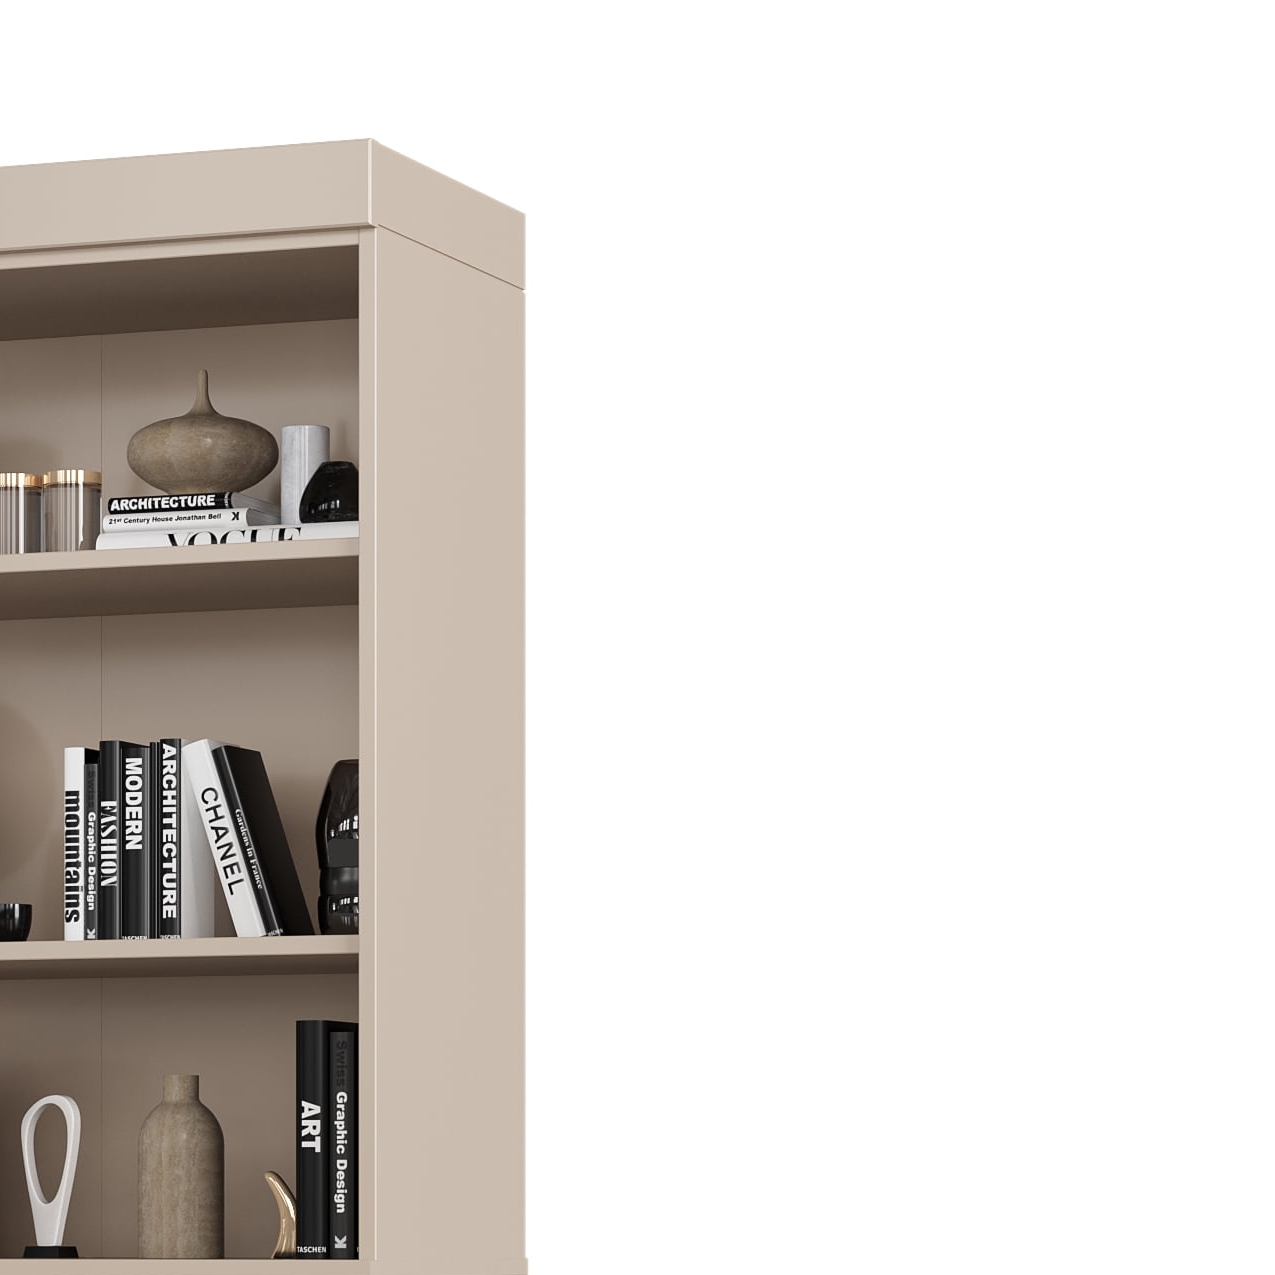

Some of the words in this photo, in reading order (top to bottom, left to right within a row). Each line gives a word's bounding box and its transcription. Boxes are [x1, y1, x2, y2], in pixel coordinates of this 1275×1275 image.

[110, 494, 216, 512] ARCHITECTURE
[123, 516, 150, 526] Century
[152, 515, 173, 523] House
[174, 514, 206, 522] Jonathan
[124, 757, 143, 850] MODERN
[162, 743, 177, 919] ARCHITECTURE
[64, 790, 82, 924] mountains
[100, 800, 118, 887] FASHION
[201, 787, 245, 895] CHANEL
[235, 808, 251, 847] Gardens
[250, 858, 263, 890] France
[300, 1100, 321, 1153] ART
[333, 1091, 348, 1155] Graphic
[333, 1159, 348, 1214] Design
[296, 1246, 327, 1254] TASCHEN
